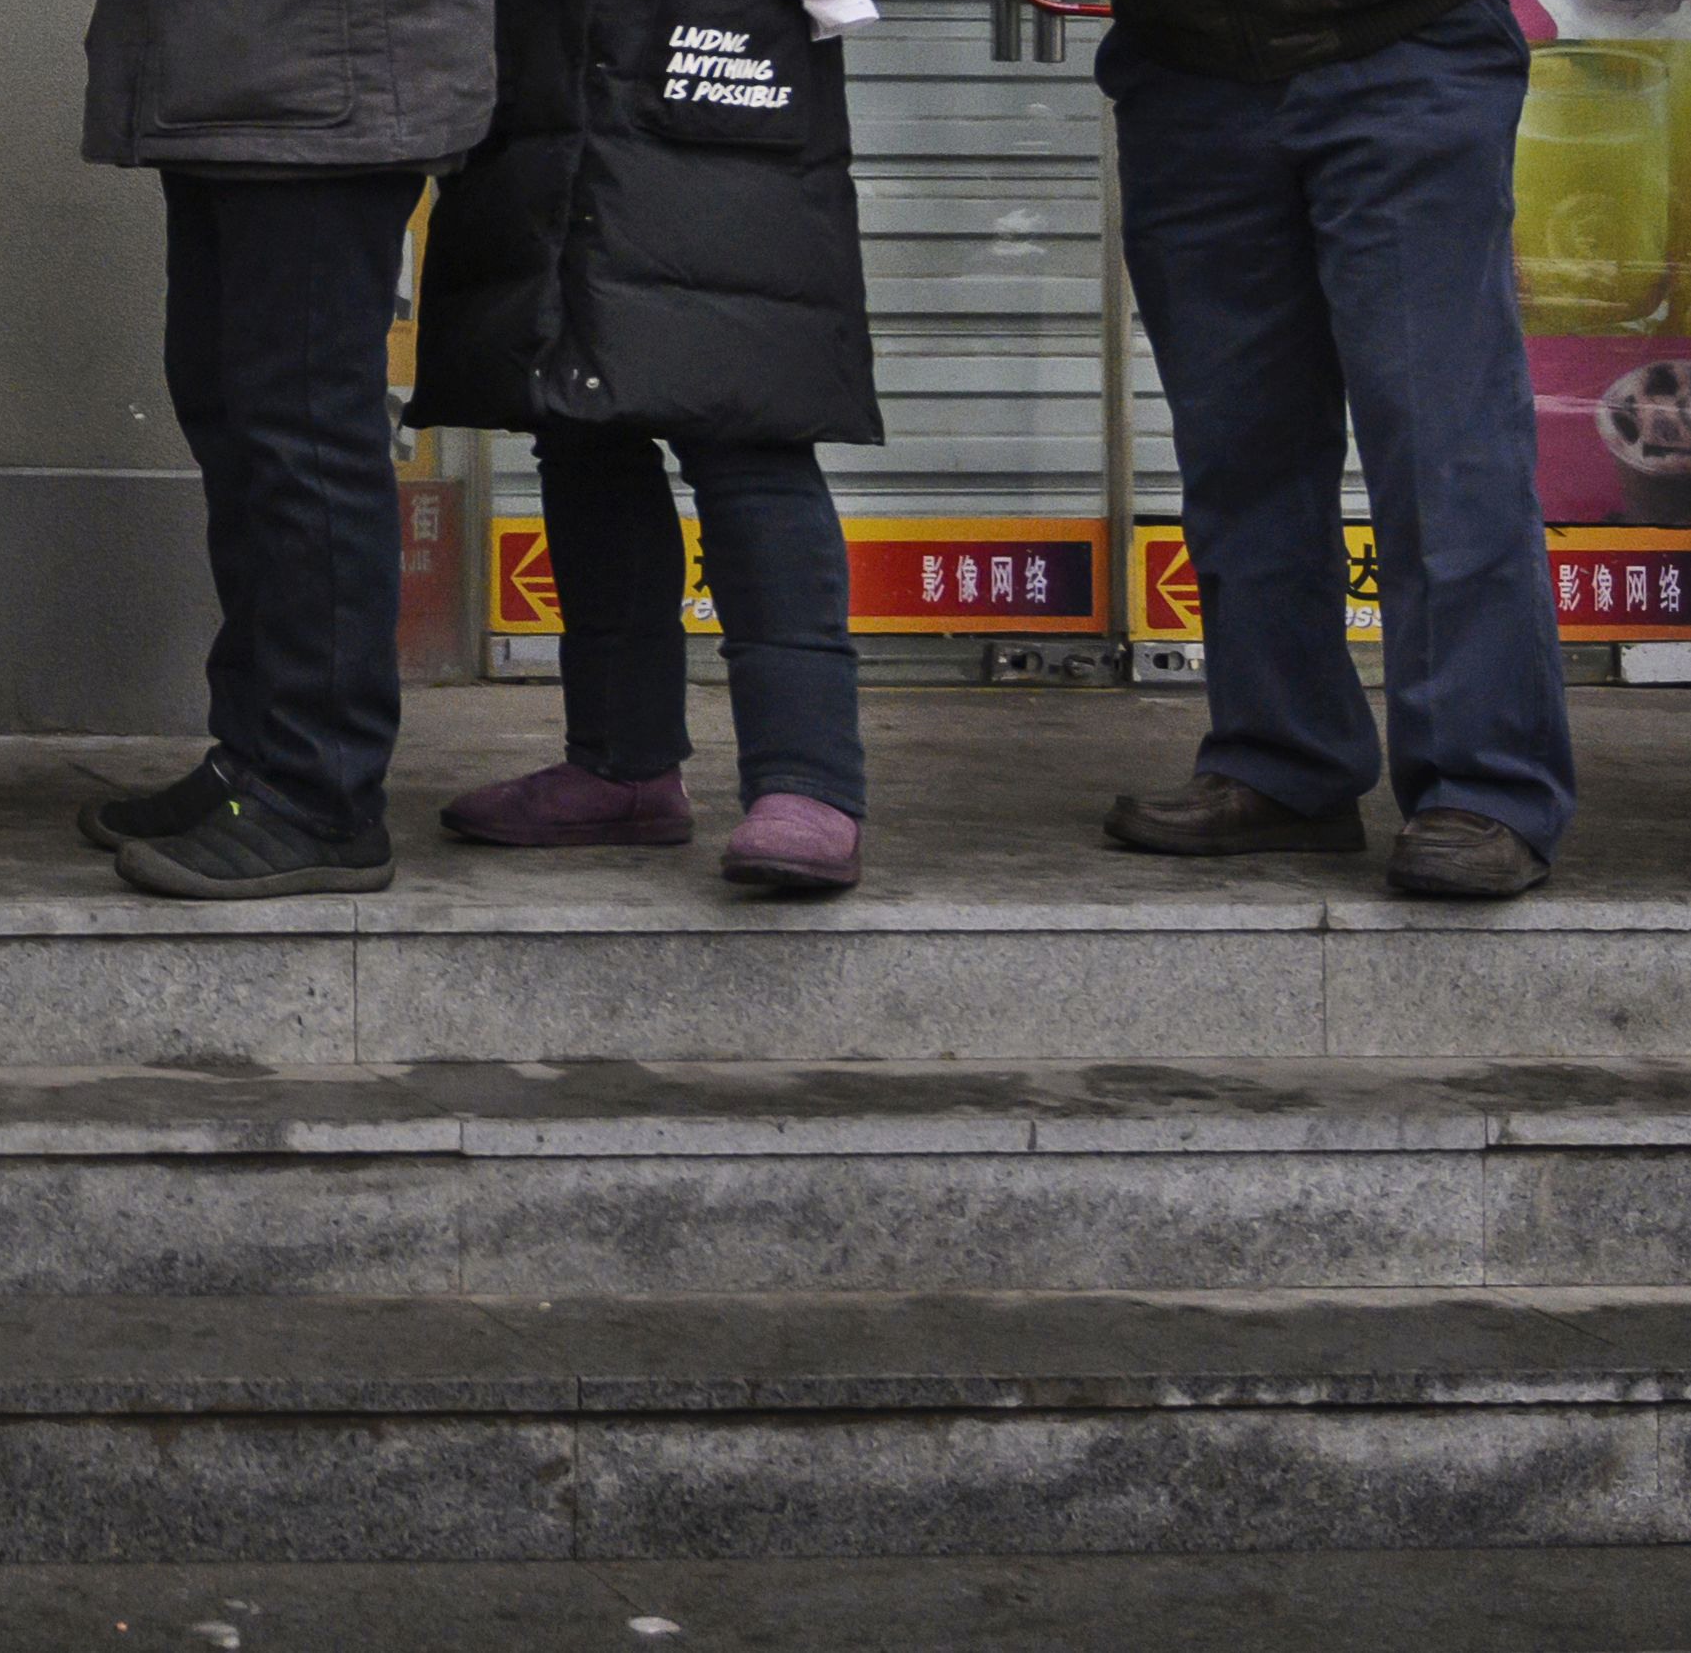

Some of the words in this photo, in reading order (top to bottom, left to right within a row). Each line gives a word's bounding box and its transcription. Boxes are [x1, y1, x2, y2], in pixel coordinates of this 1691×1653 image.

[665, 51, 774, 81] ANYTHING
[663, 78, 689, 100] IS
[691, 80, 792, 108] POSSIBLE
[921, 554, 1048, 603] 影像网络
[1557, 562, 1681, 612] 影像网络
